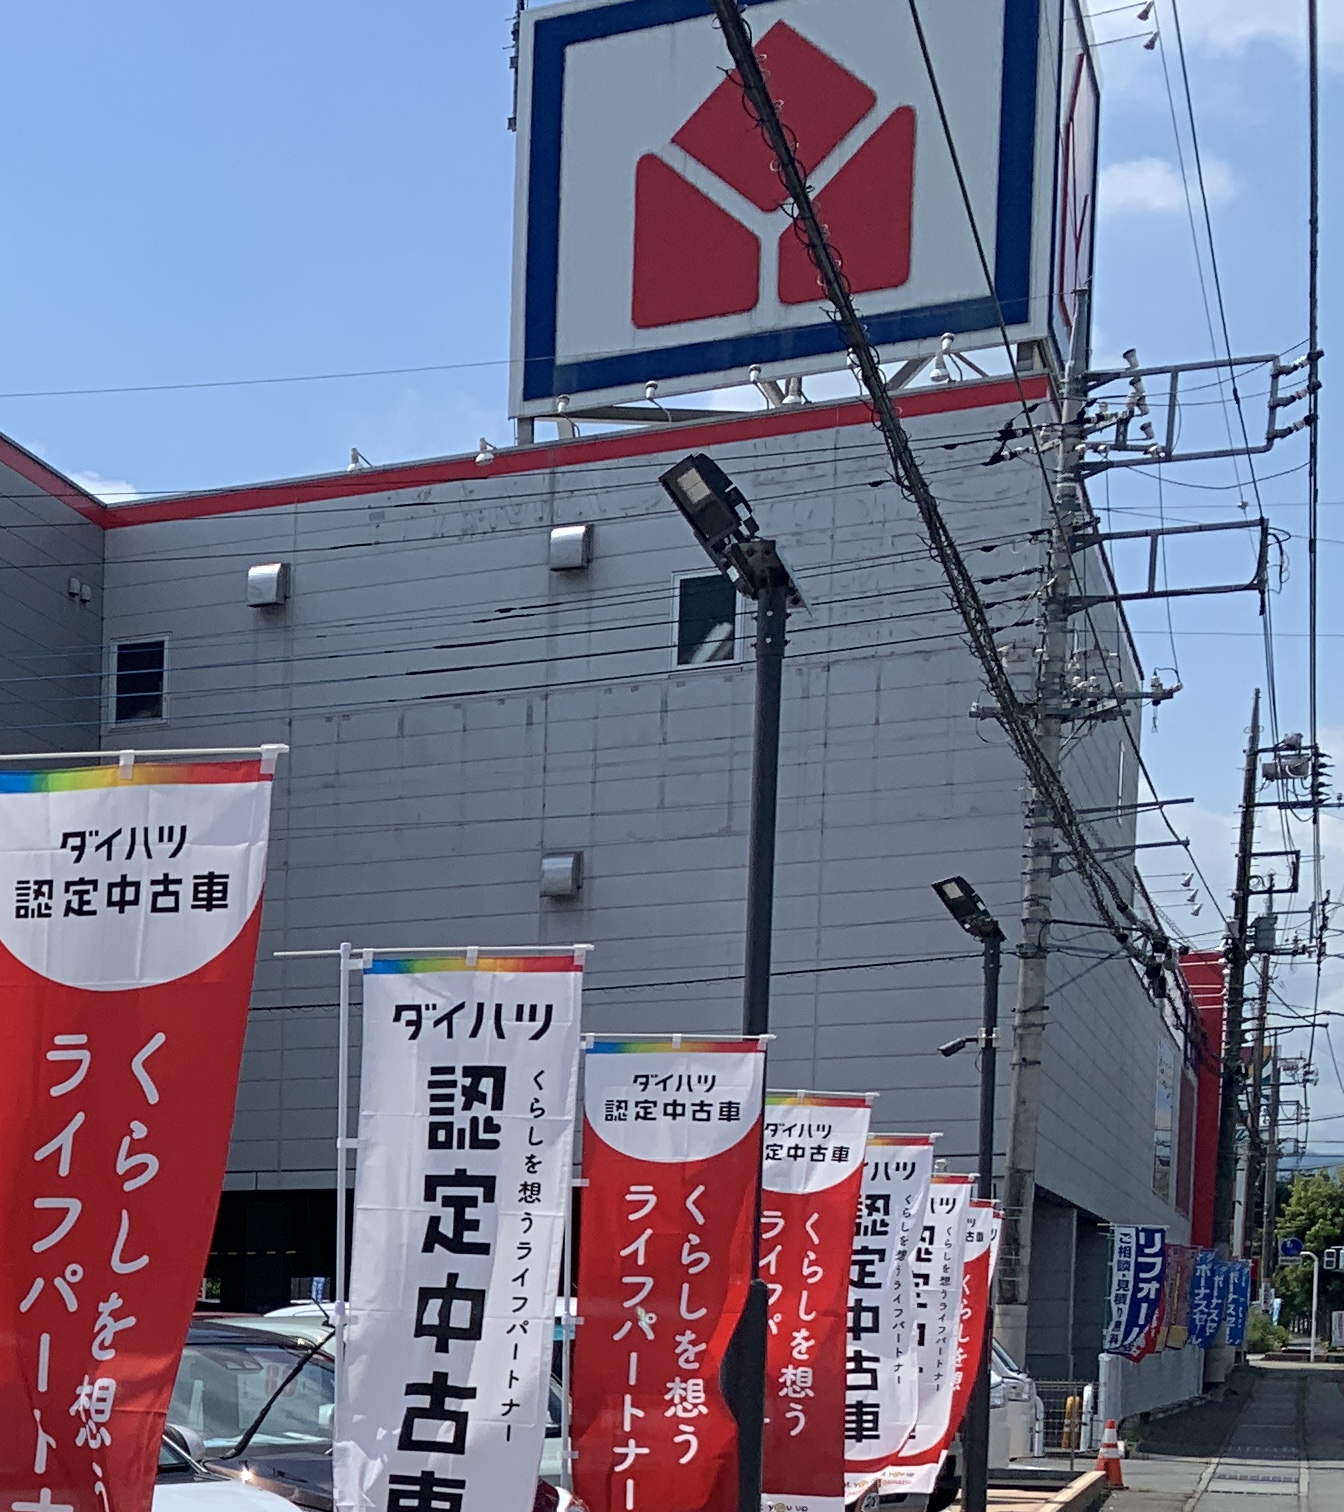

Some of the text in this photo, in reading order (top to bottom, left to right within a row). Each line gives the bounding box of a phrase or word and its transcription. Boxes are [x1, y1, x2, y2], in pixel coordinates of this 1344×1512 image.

[60, 825, 188, 863] ダイハツ
[14, 871, 231, 919] 認定中古車
[393, 1002, 553, 1040] ダイハツ
[633, 1074, 716, 1092] ダイハツ
[605, 1100, 741, 1122] 認定中古車
[765, 1123, 832, 1138] ダイハツ
[765, 1144, 849, 1162] 定中古車
[864, 1162, 916, 1181] ハツ
[501, 1070, 545, 1442] くらしを想うライフパートナー
[664, 1185, 710, 1464] くらしを想う
[779, 1213, 823, 1436] くらしを想う
[612, 1185, 657, 1511] ライフパートナー
